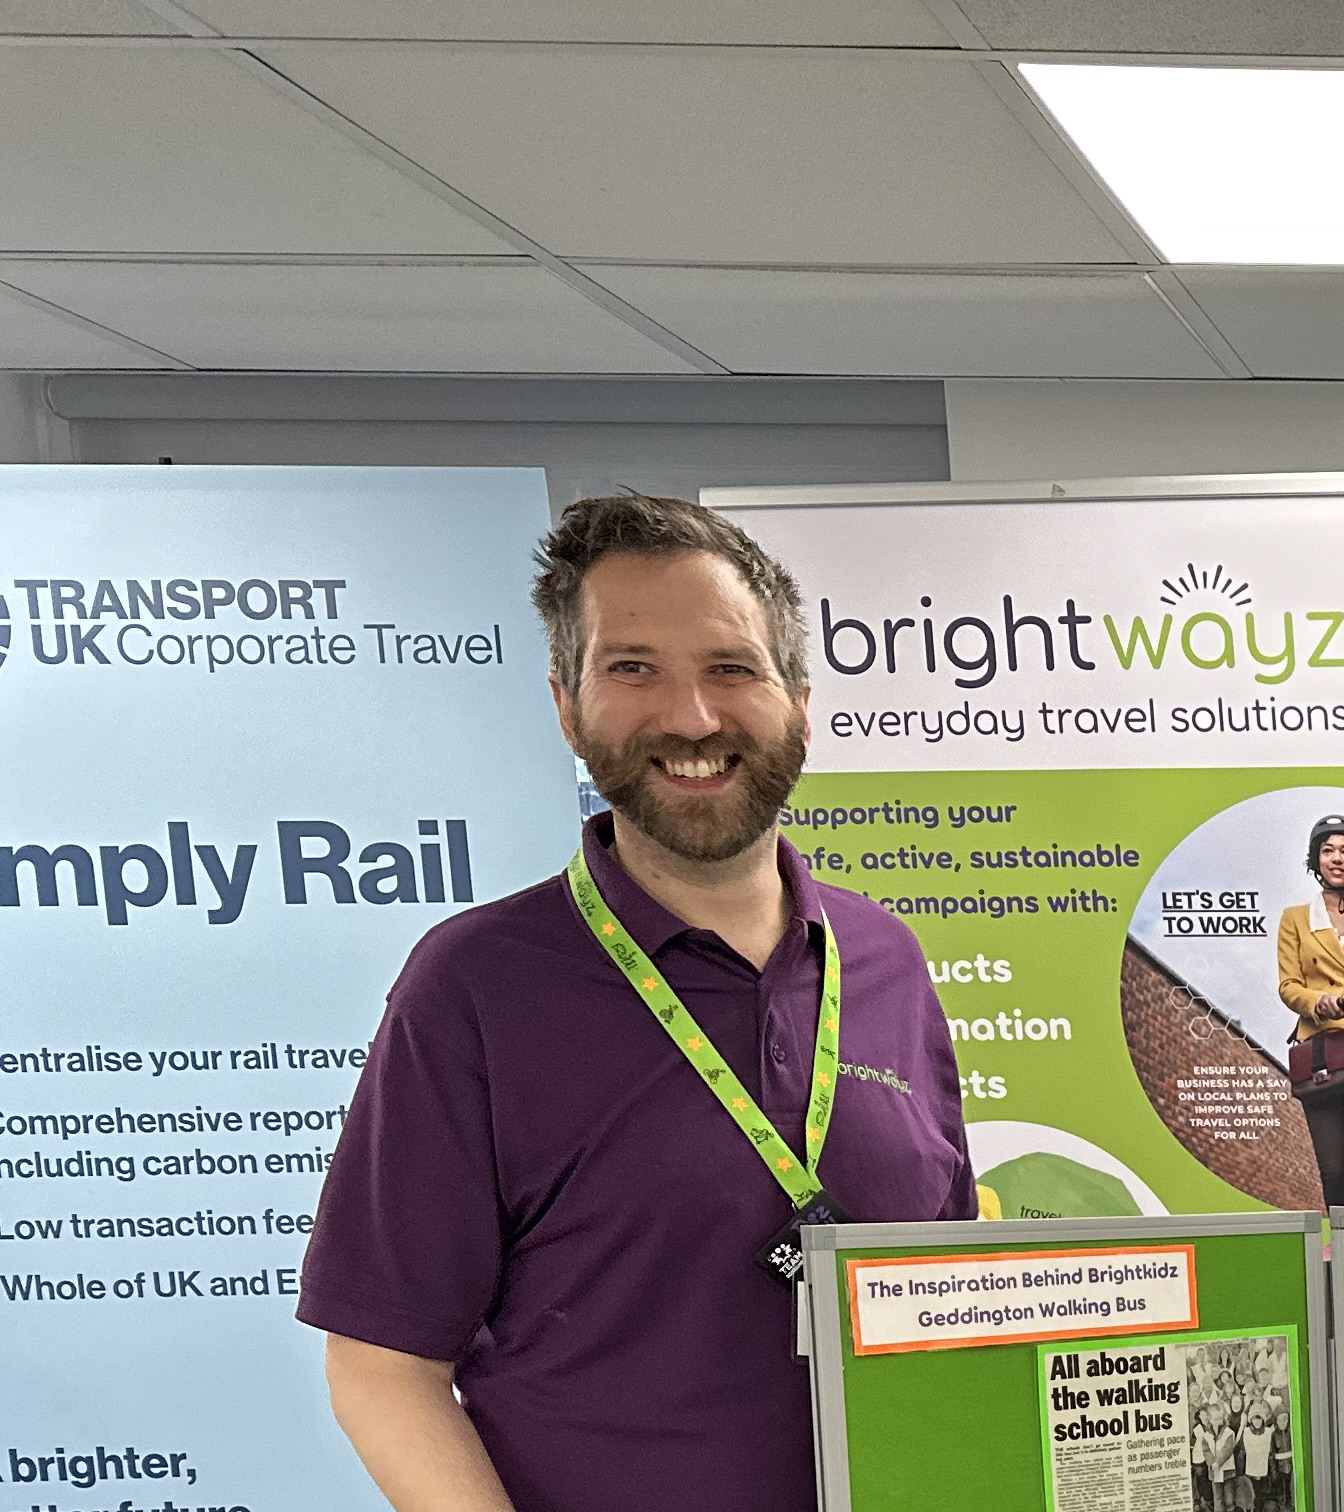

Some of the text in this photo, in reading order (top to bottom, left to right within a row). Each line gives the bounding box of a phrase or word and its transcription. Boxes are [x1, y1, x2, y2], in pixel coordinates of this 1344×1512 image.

[14, 579, 346, 620] TRANSPORT
[31, 624, 504, 673] UK Corporate Travel
[829, 700, 1027, 743] everyday
[1038, 698, 1157, 737] travel
[778, 800, 1017, 830] Supporting your
[277, 820, 474, 905] Rail
[861, 846, 961, 873] active,
[970, 844, 1140, 869] sustainable
[880, 889, 1118, 919] campaigns with:
[1162, 890, 1259, 909] LET'S GET
[1163, 916, 1266, 934] TO WORK
[149, 1046, 223, 1077] your
[230, 1043, 279, 1070] rail
[285, 1042, 373, 1069] trave
[1193, 1066, 1269, 1075] ENSURE YOUR
[1177, 1079, 1229, 1088] BUSINESS
[1233, 1118, 1280, 1127] OPTIONS
[1246, 1105, 1273, 1114] SAFE
[1214, 1131, 1259, 1140] FOR ALL
[142, 1149, 258, 1178] carbon
[70, 1211, 257, 1240] transaction
[1020, 1205, 1062, 1220] trave
[1, 1270, 269, 1302] Whole of UK and
[867, 1263, 1179, 1299] The Inspiration Behind Brightkidz
[918, 1296, 1146, 1328] Geddington Walking Bus
[1050, 1346, 1166, 1381] All aboard
[1051, 1379, 1181, 1411] the walking
[1054, 1408, 1172, 1441] school bus
[1127, 1437, 1165, 1450] Gathering
[1140, 1448, 1180, 1462] passenger
[9, 1446, 198, 1489] brighter,
